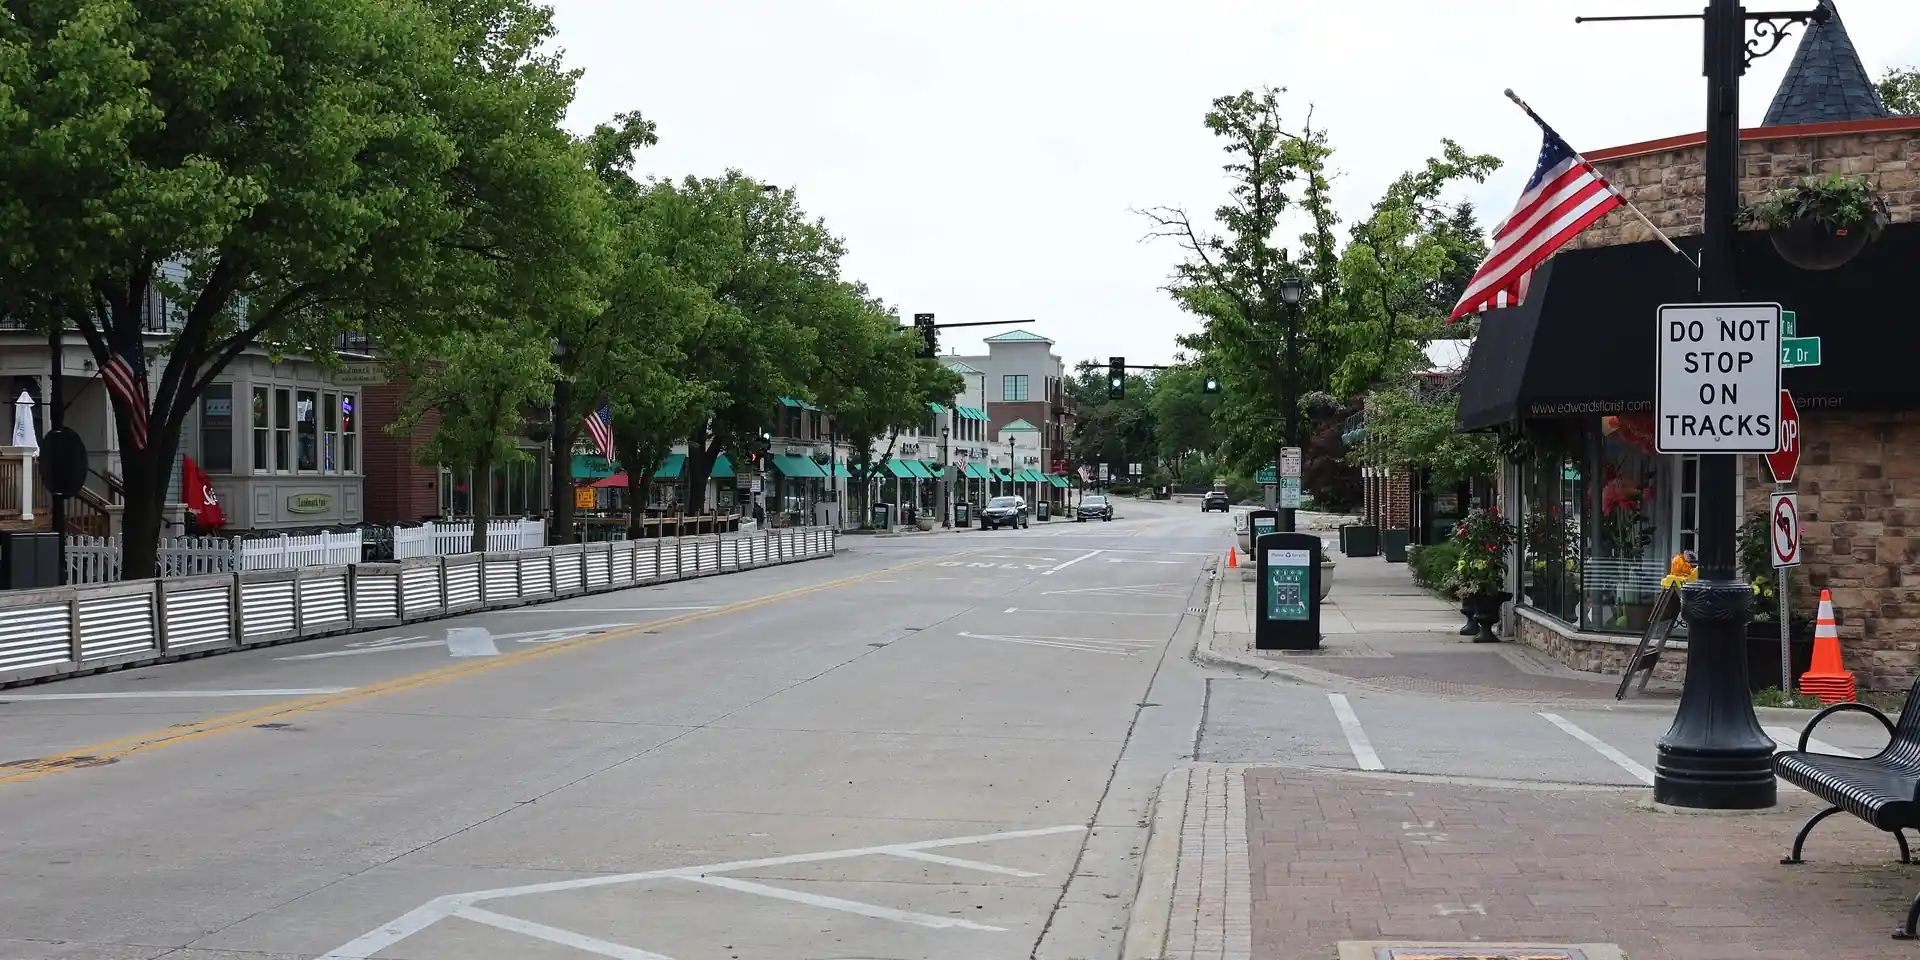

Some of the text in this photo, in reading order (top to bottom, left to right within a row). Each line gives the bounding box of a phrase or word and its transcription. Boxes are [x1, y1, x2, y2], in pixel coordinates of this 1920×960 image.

[1670, 320, 1704, 342] DO
[1720, 319, 1770, 342] NOT
[1683, 351, 1755, 373] STOP
[1796, 347, 1809, 362] Dr
[1699, 383, 1738, 405] ON
[1795, 396, 1844, 409] ermer
[1530, 399, 1652, 414] www.edwardsflorist.com
[1665, 414, 1772, 437] TRACKS
[1781, 419, 1797, 452] OP
[934, 560, 1054, 571] ONLY
